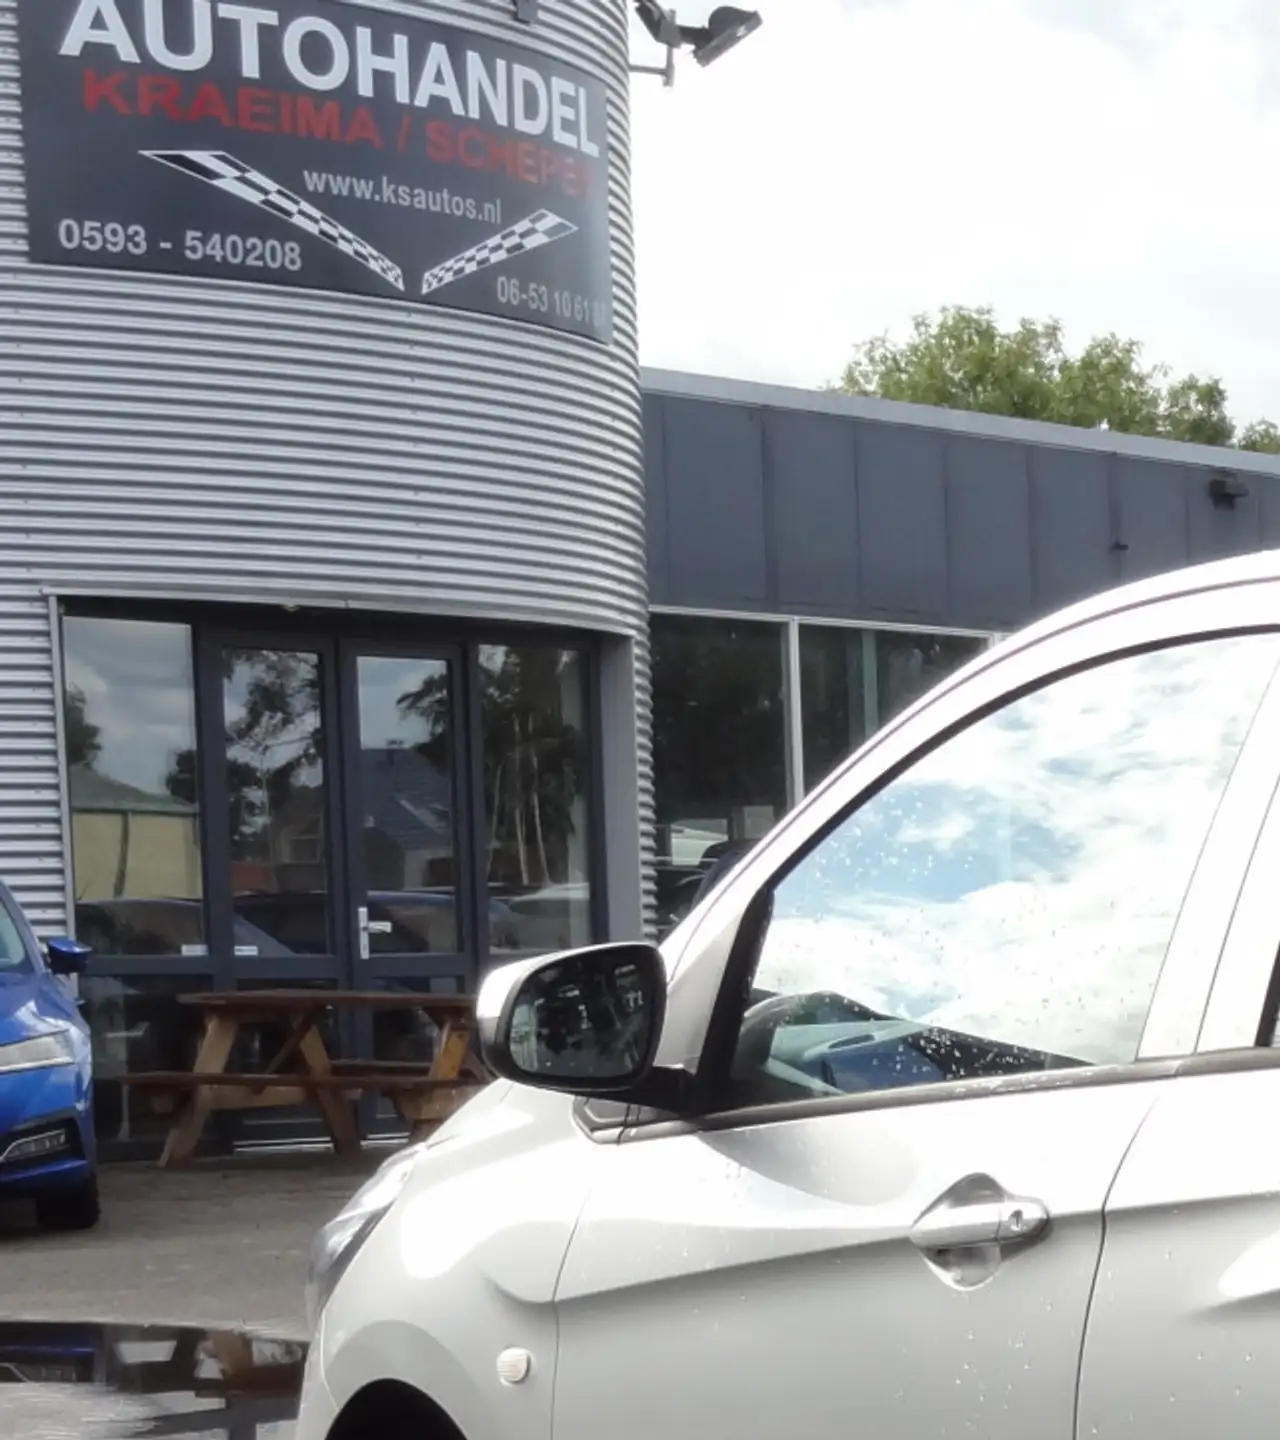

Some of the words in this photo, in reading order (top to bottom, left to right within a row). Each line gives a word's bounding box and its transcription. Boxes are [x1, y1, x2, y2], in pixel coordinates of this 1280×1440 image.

[59, 0, 599, 157] AUTOHANDEL
[82, 68, 383, 151] KRAEIMA
[303, 169, 501, 224] www.ksautos.nl
[58, 218, 147, 255] 0593
[183, 230, 302, 271] 540208
